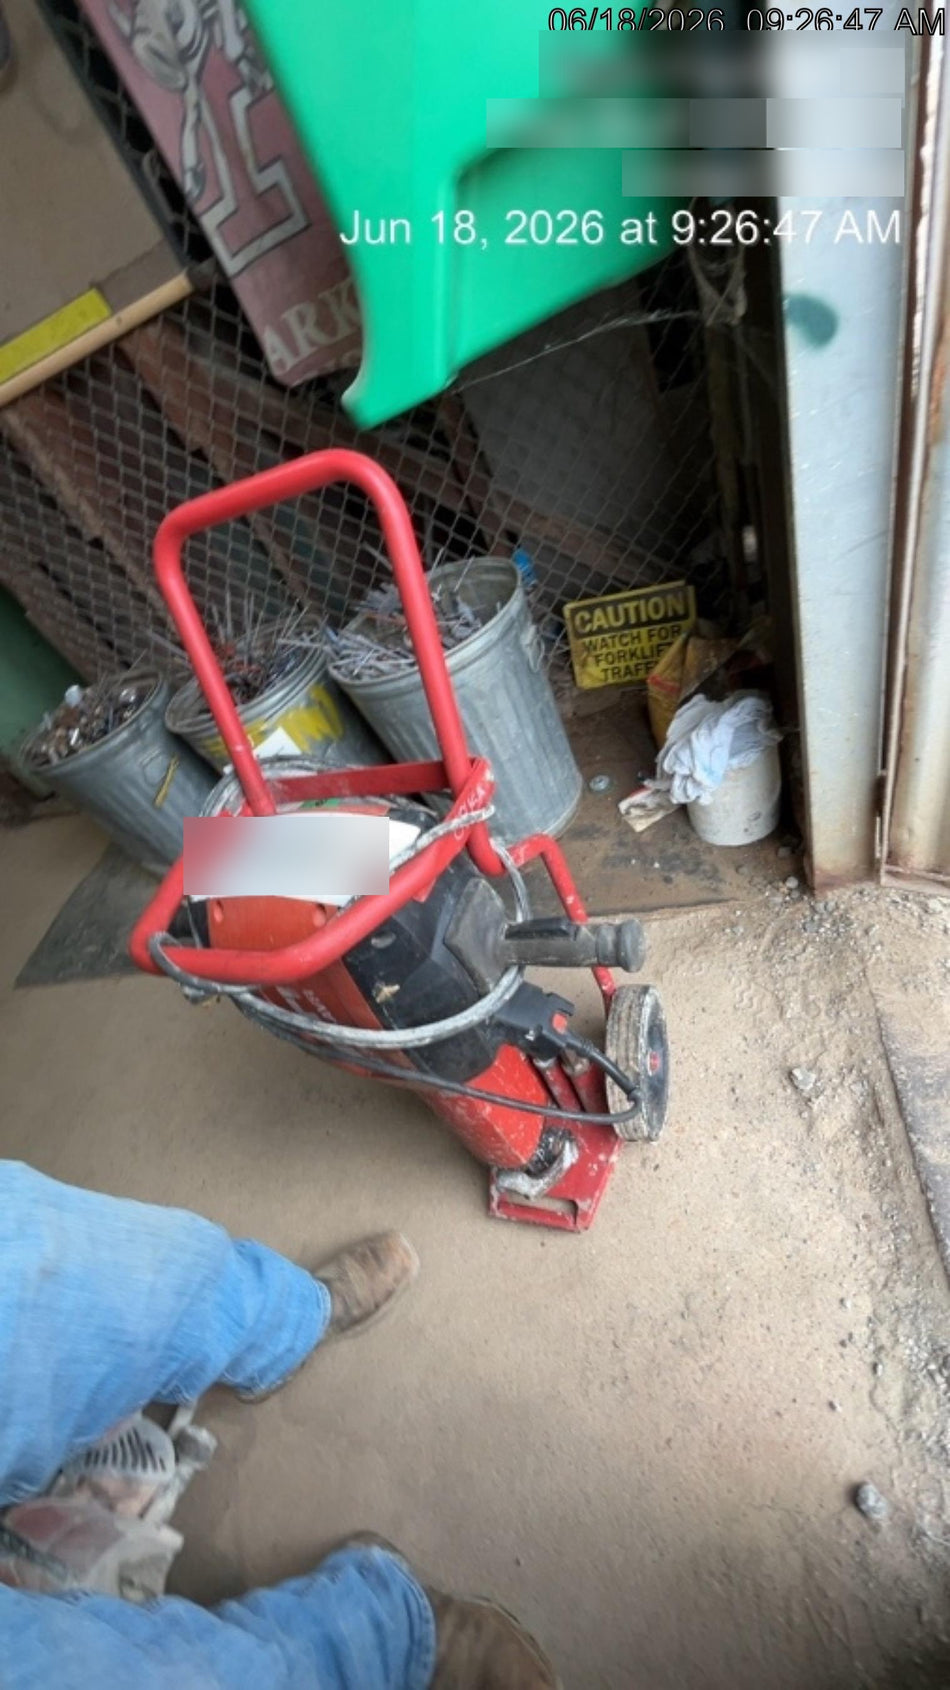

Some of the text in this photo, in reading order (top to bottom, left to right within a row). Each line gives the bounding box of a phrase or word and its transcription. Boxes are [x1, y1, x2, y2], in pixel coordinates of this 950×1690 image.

[574, 592, 686, 633] CAUTION
[584, 624, 681, 652] WATCH FOR
[600, 661, 659, 682] TRAFF
